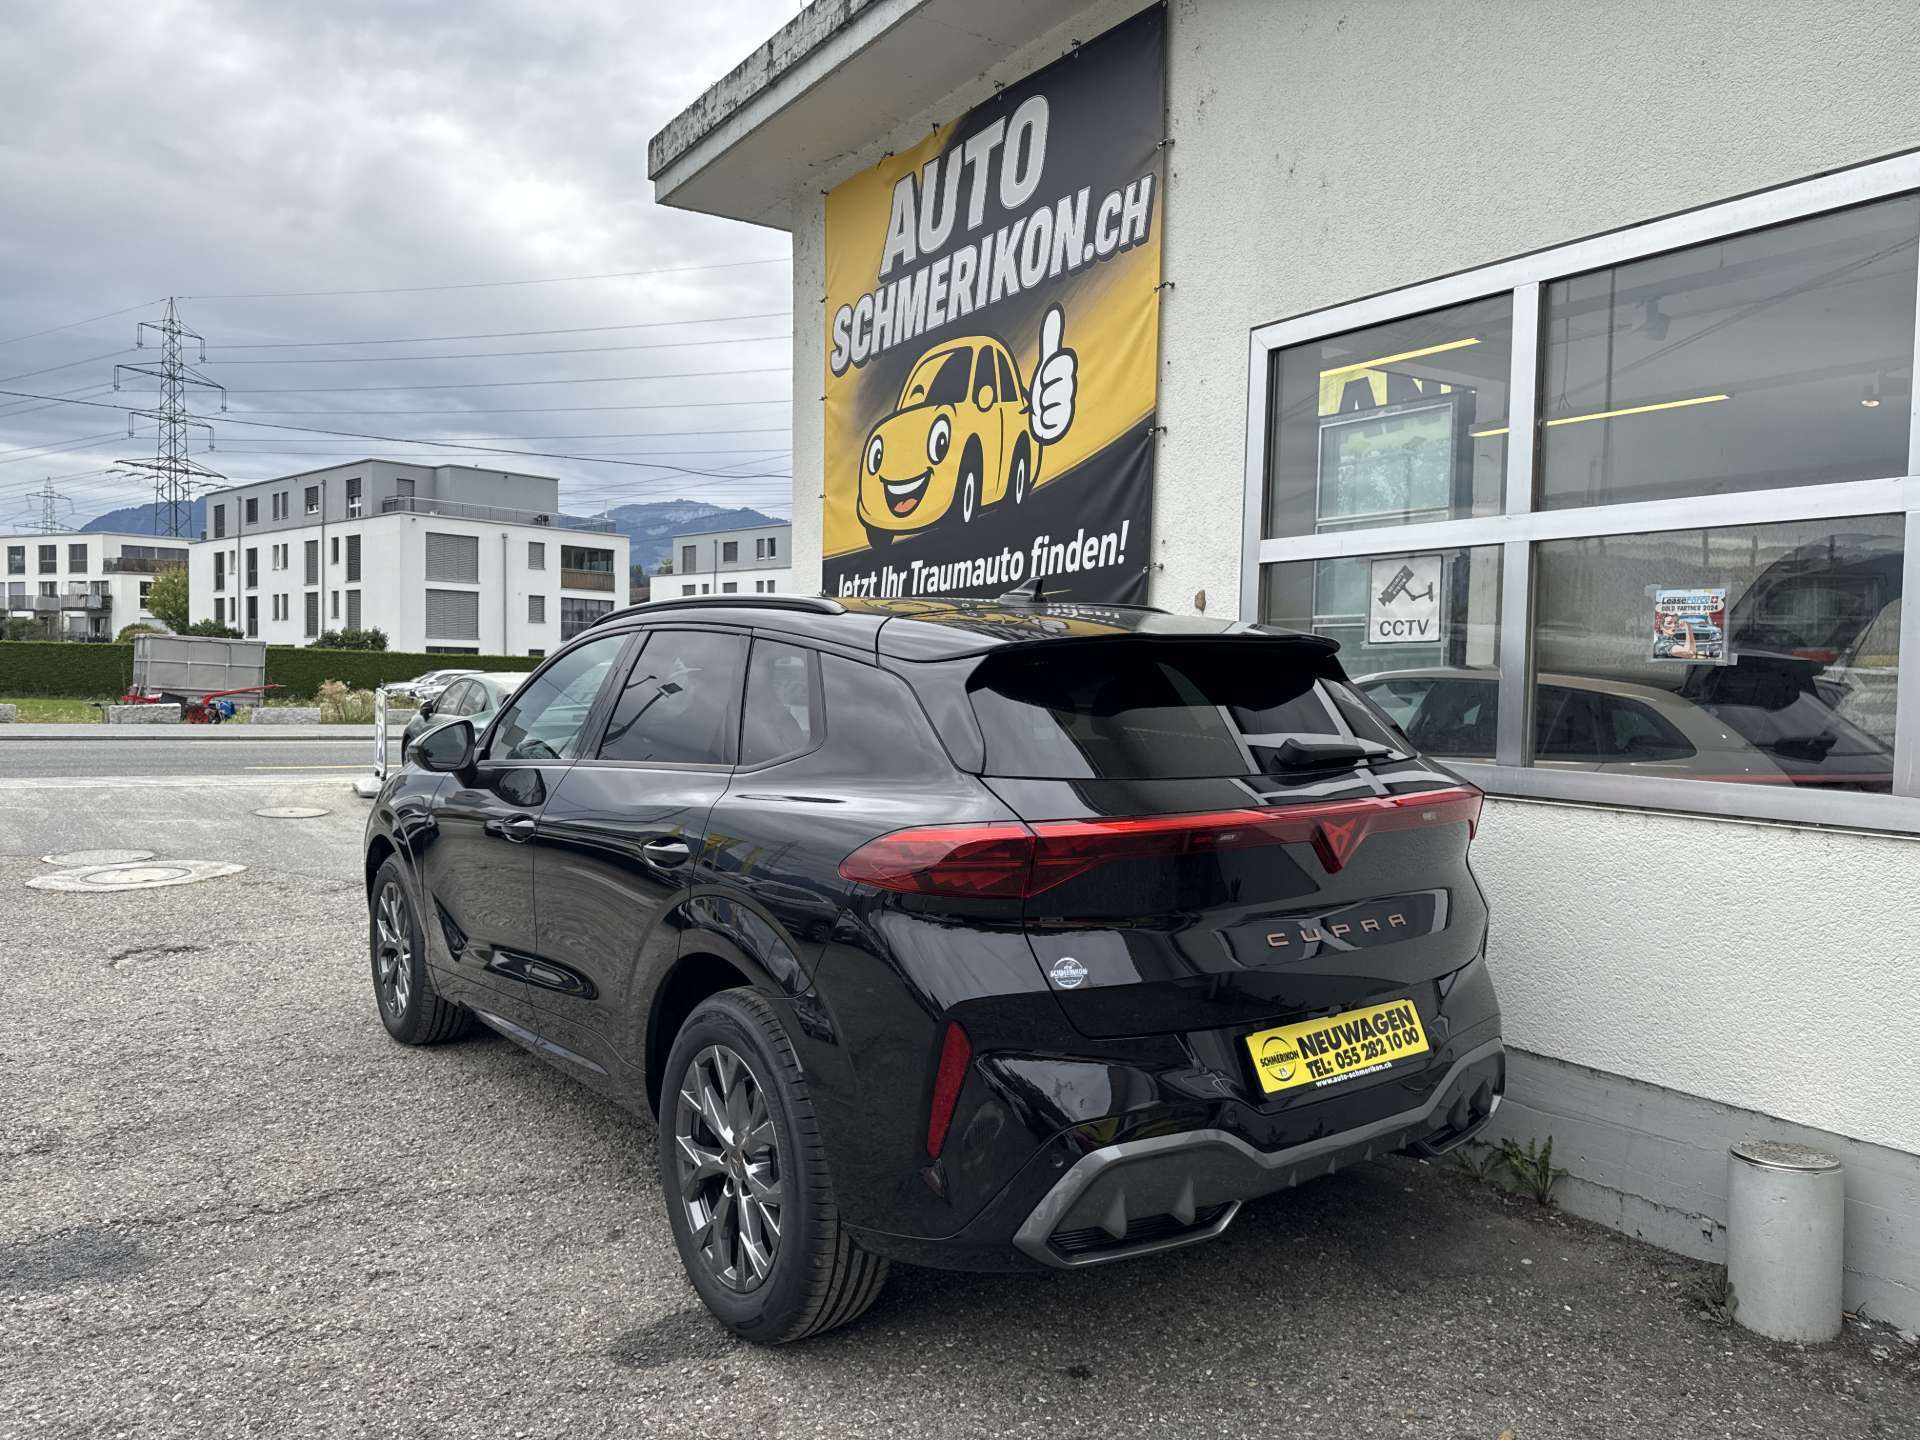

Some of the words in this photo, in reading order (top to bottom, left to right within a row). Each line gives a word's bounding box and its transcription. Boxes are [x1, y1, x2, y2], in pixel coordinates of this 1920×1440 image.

[879, 94, 1050, 276] AUTO
[830, 173, 1154, 374] SCHMERIKON.CH
[838, 570, 878, 598] Jetzt
[880, 565, 908, 598] Ihr
[910, 549, 1024, 596] Traumauto
[1030, 519, 1130, 577] finden!
[1379, 619, 1429, 637] CCTV
[1267, 913, 1407, 948] CUPRA
[1259, 1049, 1300, 1068] SCHMERIKON
[1296, 1004, 1416, 1060] NEUWAGEN
[1305, 1058, 1334, 1080] TEL:
[1334, 1046, 1361, 1069] 055
[1360, 1039, 1388, 1061] 282
[1386, 1032, 1402, 1052] 10
[1402, 1026, 1420, 1046] 00
[1315, 1061, 1393, 1088] www.auto-schmerikon.ch
